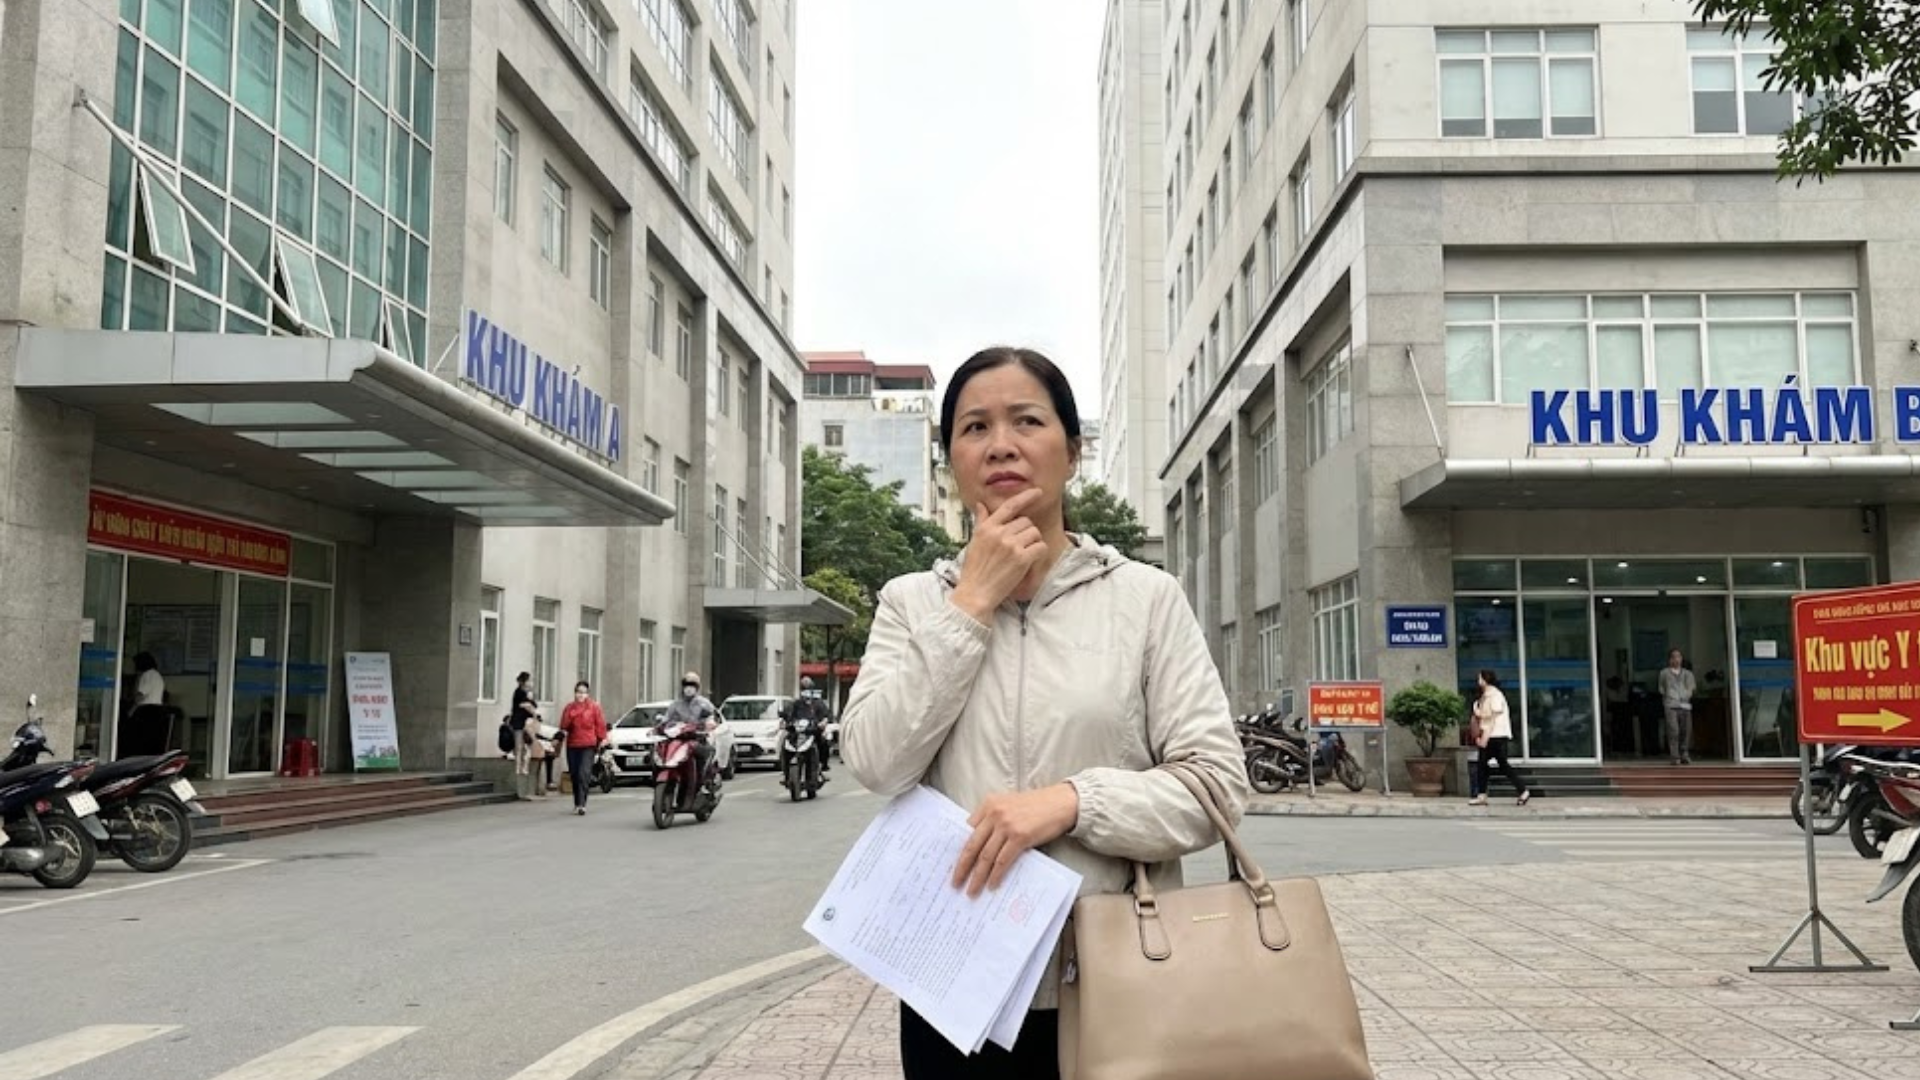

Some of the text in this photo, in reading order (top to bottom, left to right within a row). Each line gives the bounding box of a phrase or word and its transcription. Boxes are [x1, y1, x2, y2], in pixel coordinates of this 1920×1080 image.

[467, 309, 620, 462] KHU KHÁM A
[1531, 375, 1920, 443] KHU KHÁM B
[1805, 637, 1845, 673] Khu
[1850, 634, 1891, 680] vực
[1896, 630, 1911, 669] Y
